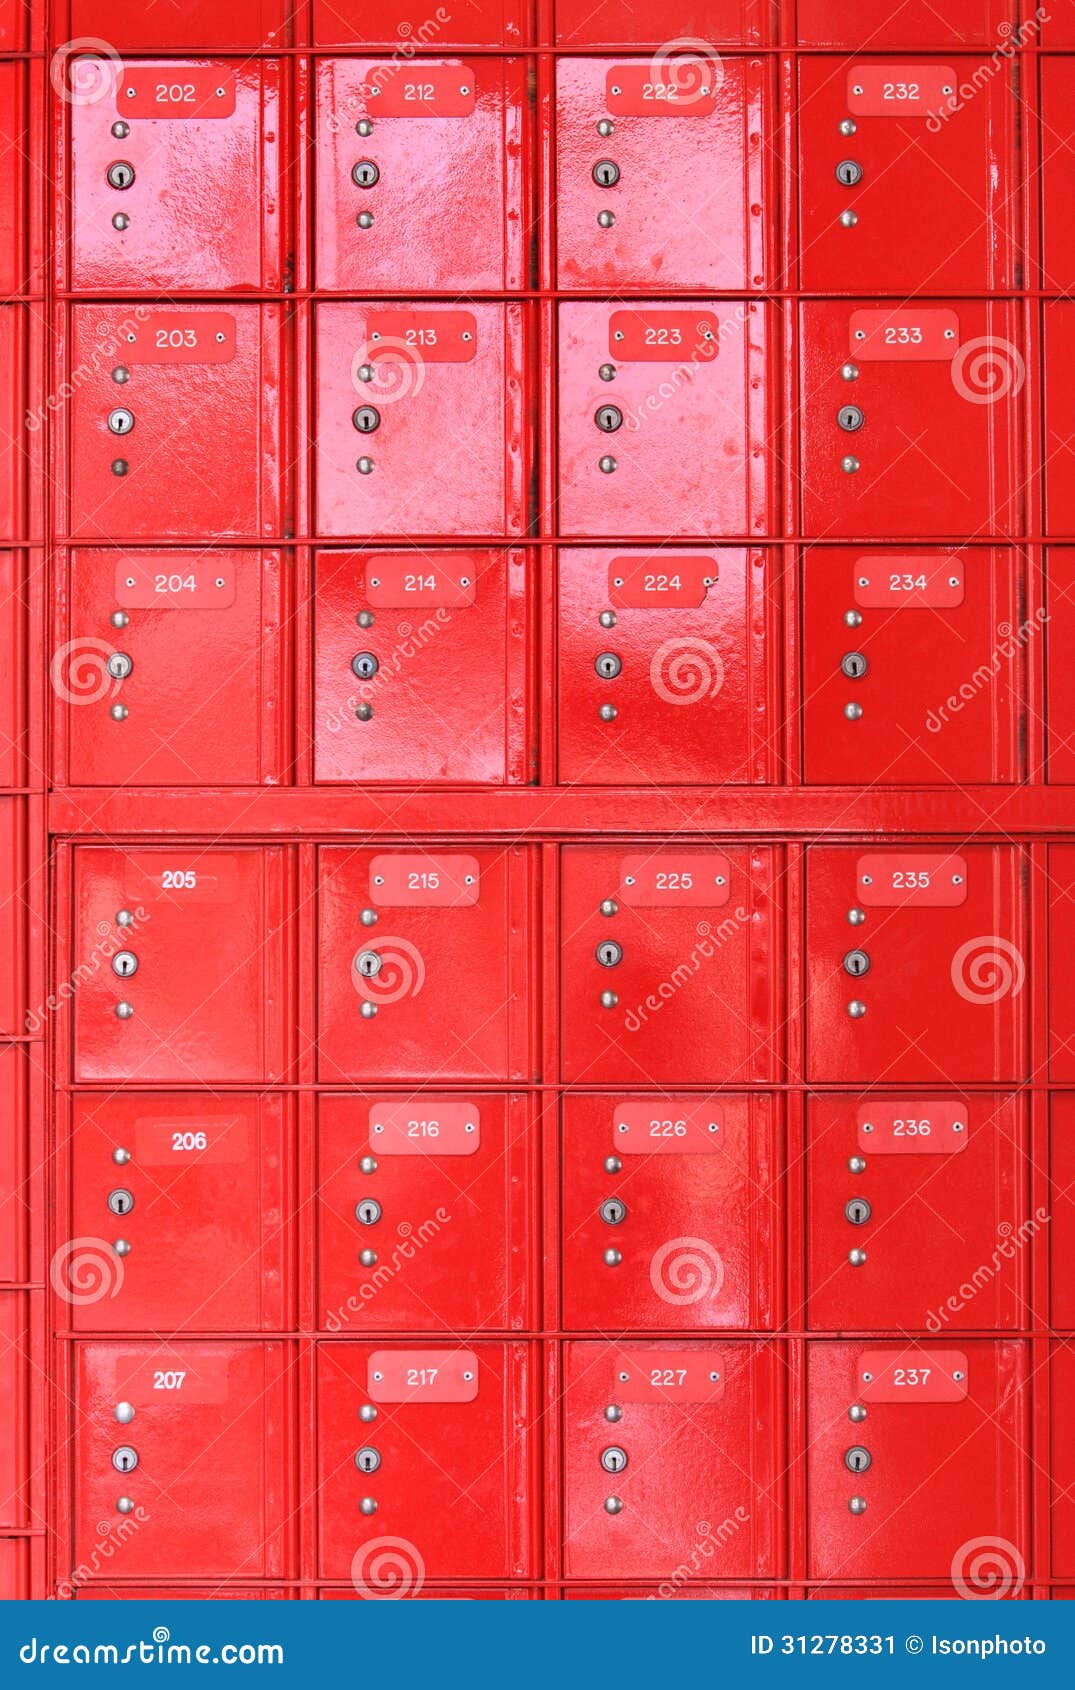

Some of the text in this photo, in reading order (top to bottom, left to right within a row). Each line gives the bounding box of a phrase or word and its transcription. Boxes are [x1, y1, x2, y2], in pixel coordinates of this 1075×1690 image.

[155, 84, 196, 103] 202
[404, 83, 435, 101] 212
[641, 82, 680, 101] 222
[883, 83, 920, 100] 232
[155, 329, 198, 348] 203
[404, 328, 437, 347] 213
[645, 328, 682, 345] 223
[885, 327, 923, 344] 233
[155, 574, 197, 593] 204
[404, 574, 437, 592] 214
[644, 574, 682, 592] 224
[889, 574, 928, 591] 234
[161, 870, 196, 889] 205
[408, 872, 440, 889] 215
[655, 872, 693, 890] 225
[892, 871, 930, 889] 235
[407, 1120, 440, 1137] 216
[649, 1120, 687, 1137] 226
[893, 1119, 931, 1136] 236
[172, 1131, 207, 1151] 206
[153, 1371, 186, 1390] 207
[407, 1368, 439, 1386] 217
[650, 1369, 688, 1386] 227
[894, 1368, 931, 1386] 237
